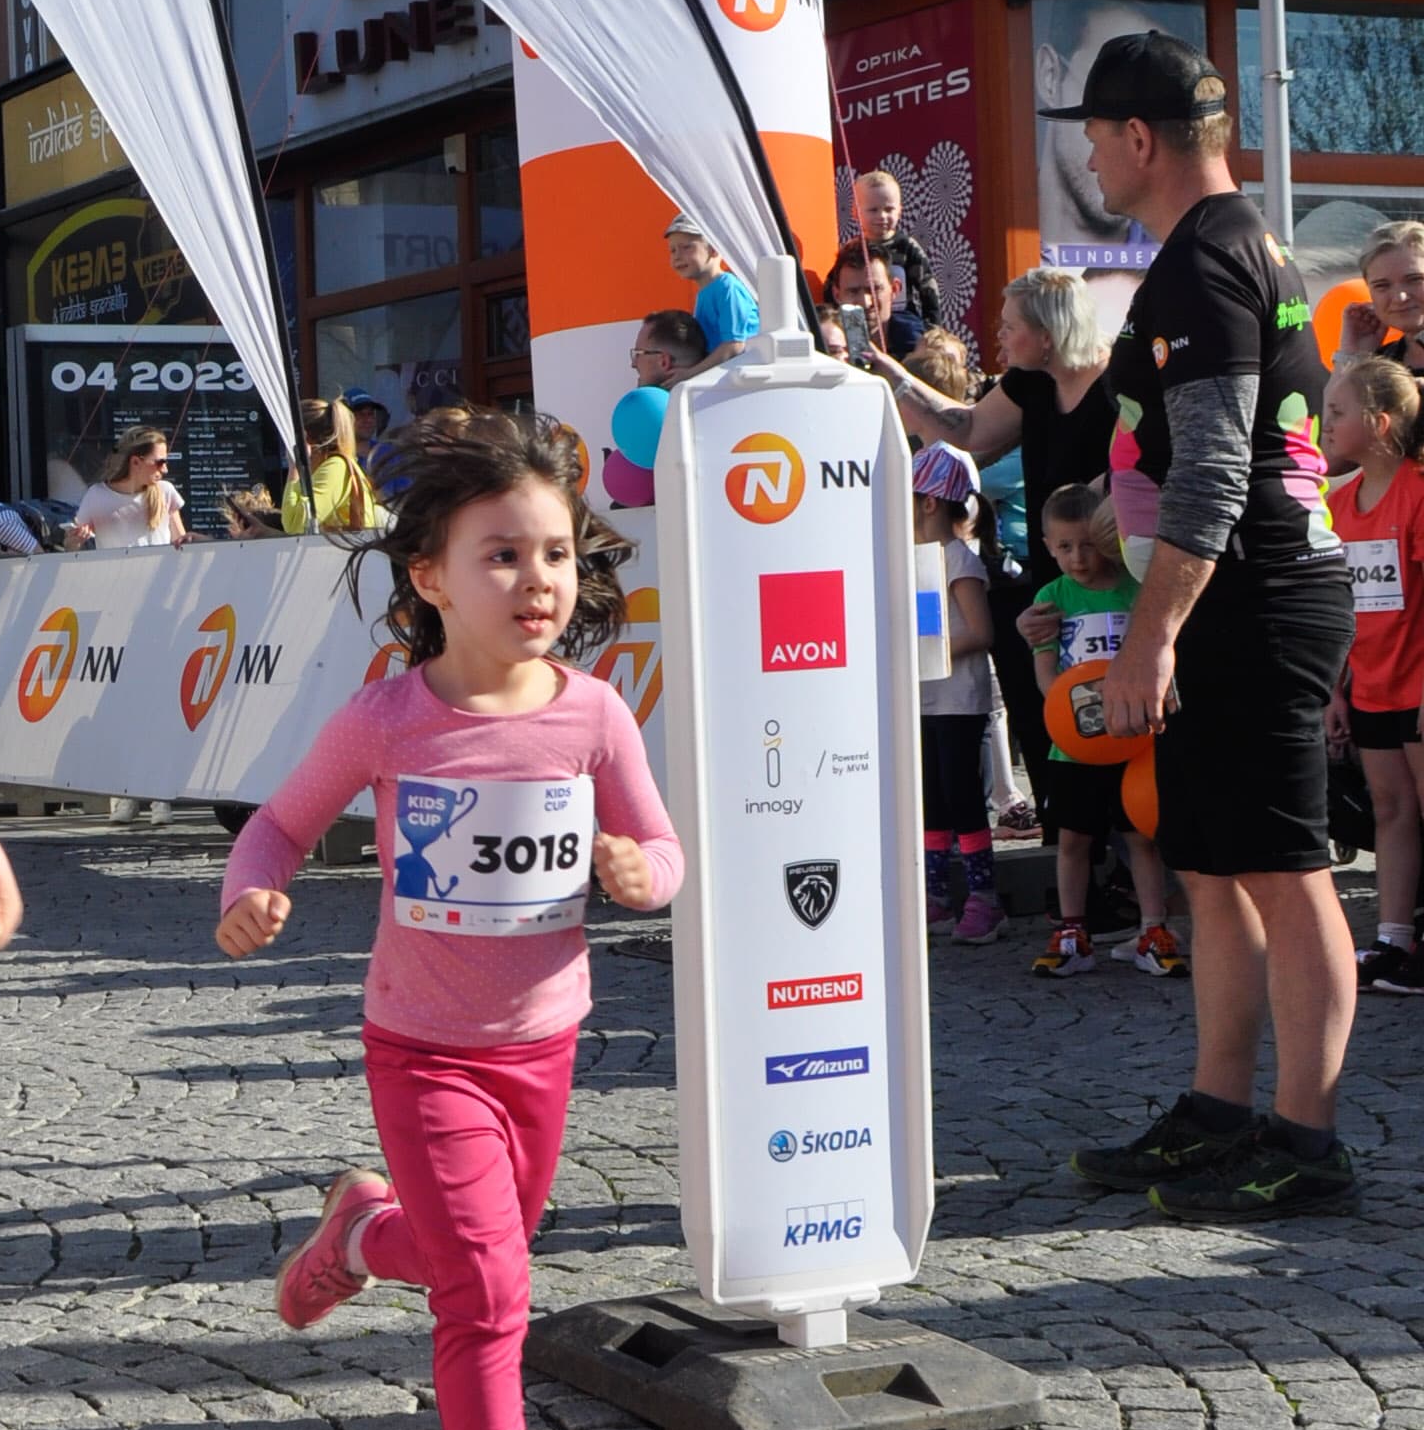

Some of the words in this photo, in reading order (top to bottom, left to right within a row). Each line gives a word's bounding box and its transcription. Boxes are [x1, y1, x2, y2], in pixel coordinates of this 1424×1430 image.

[856, 44, 922, 73] OPTIKA
[836, 67, 971, 124] UNETTES
[51, 361, 118, 392] 04
[129, 361, 257, 392] 2023
[821, 459, 871, 489] NN
[770, 641, 838, 664] AVON
[1085, 634, 1125, 654] 315
[80, 646, 125, 684] NN
[234, 644, 282, 685] NN
[407, 794, 447, 810] KIDS
[544, 799, 568, 812] CUP
[545, 787, 572, 799] KIDS
[744, 797, 804, 815] innogy
[407, 813, 442, 828] CUP
[469, 832, 580, 875] 3018
[788, 864, 836, 875] PEUGEOT
[772, 980, 860, 1004] NUTREND
[802, 1127, 873, 1155] ŠKODA
[783, 1215, 863, 1248] KPMG
